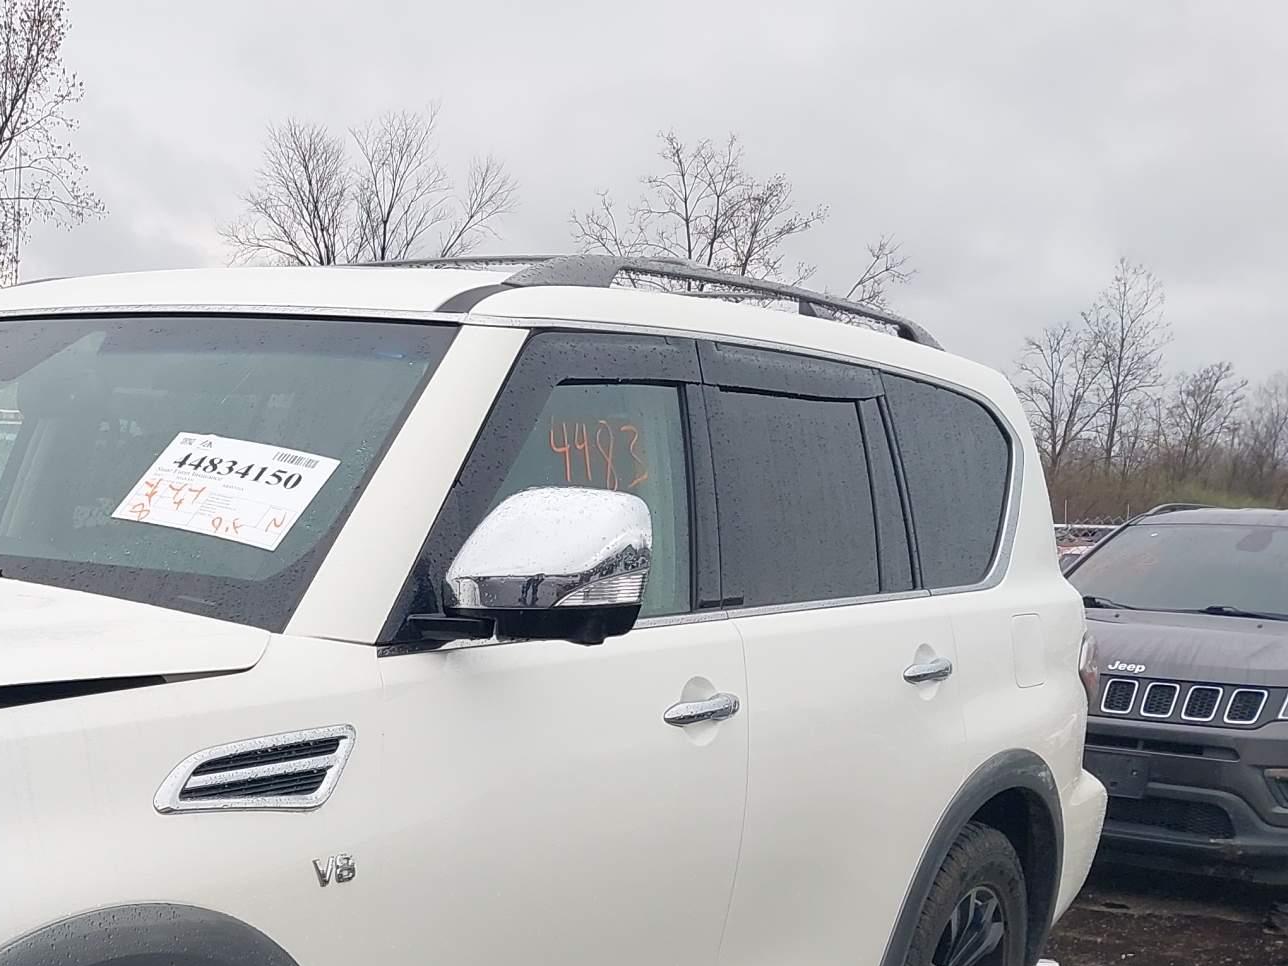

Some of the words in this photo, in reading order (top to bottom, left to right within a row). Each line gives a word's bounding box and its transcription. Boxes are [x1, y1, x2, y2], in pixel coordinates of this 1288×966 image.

[173, 452, 302, 490] 44834150
[1107, 660, 1146, 674] Jeep
[312, 854, 356, 887] V8
